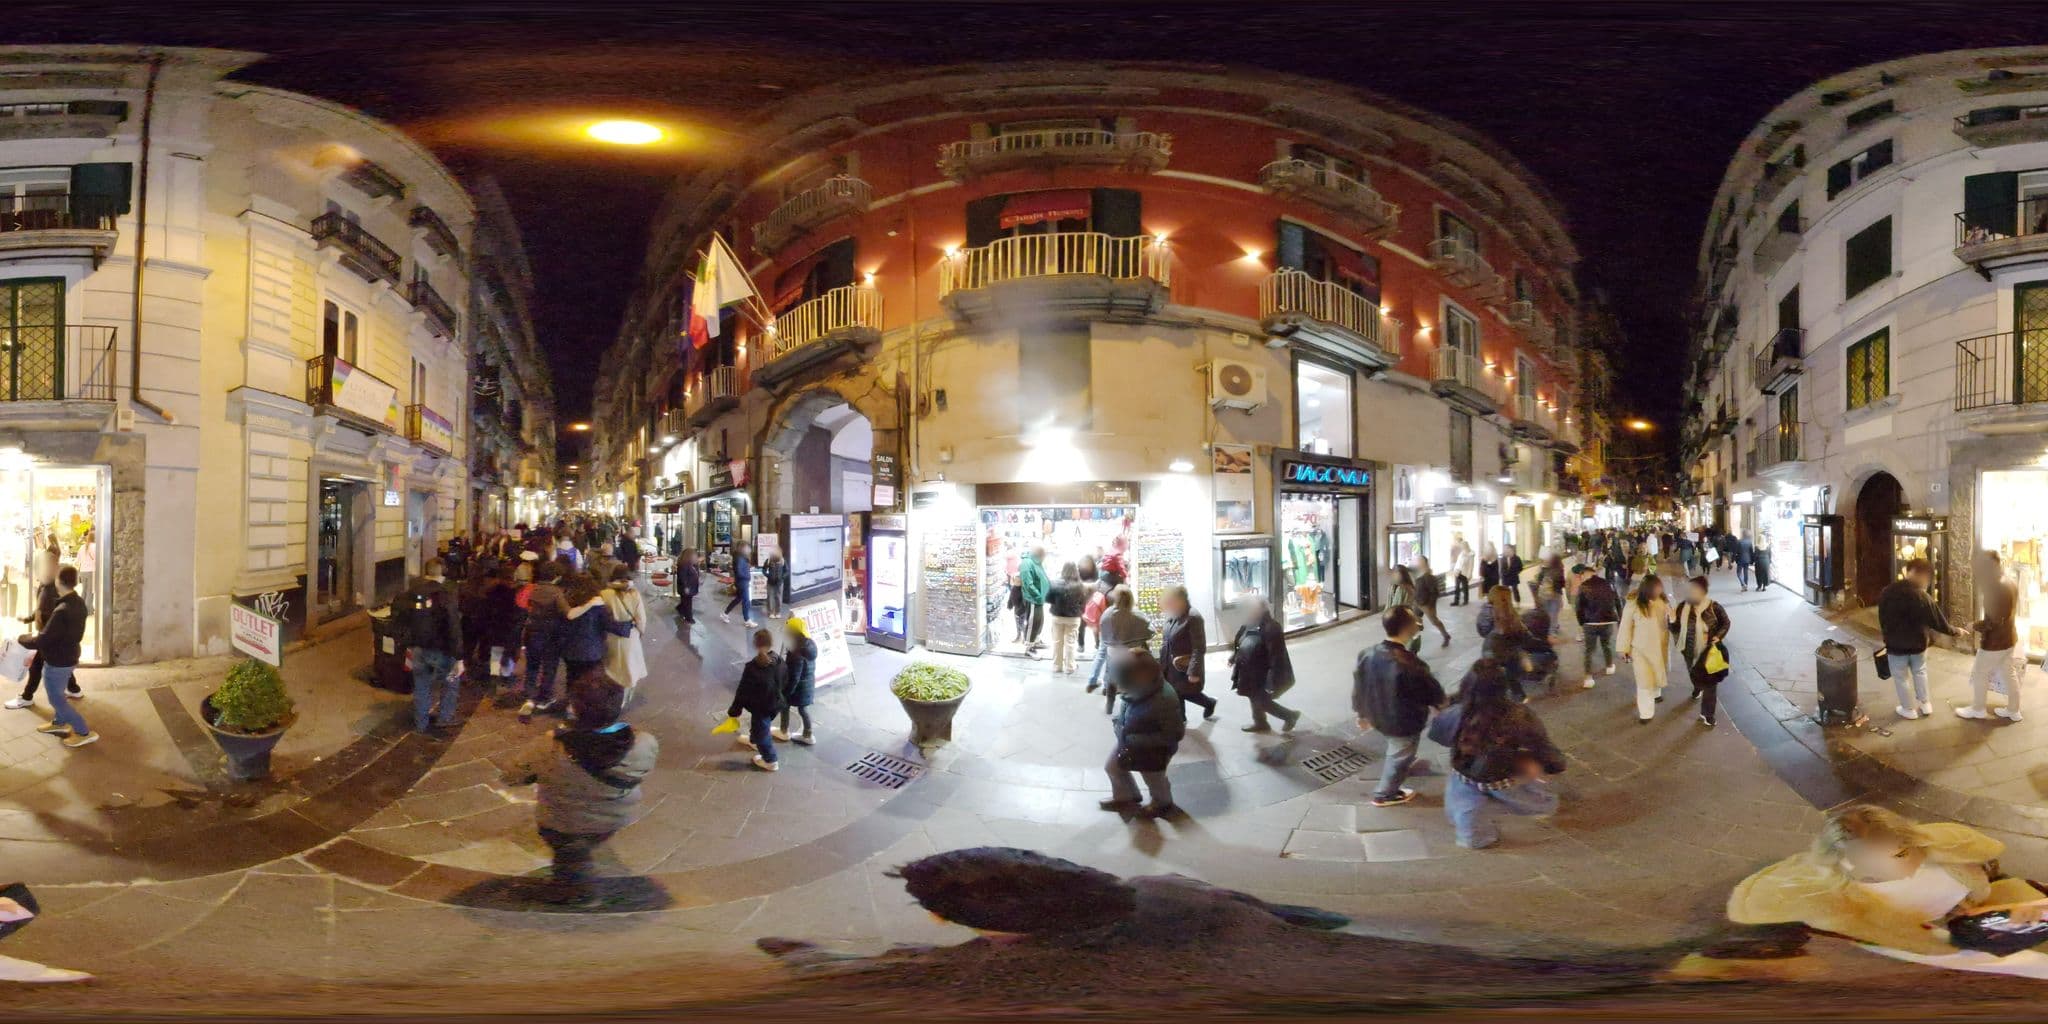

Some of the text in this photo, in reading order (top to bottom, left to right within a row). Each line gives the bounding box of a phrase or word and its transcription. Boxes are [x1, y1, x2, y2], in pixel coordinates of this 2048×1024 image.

[876, 454, 893, 463] SALON
[1284, 463, 1372, 486] DIAGONALE
[233, 608, 275, 638] OUTLET
[806, 607, 837, 631] UTLET
